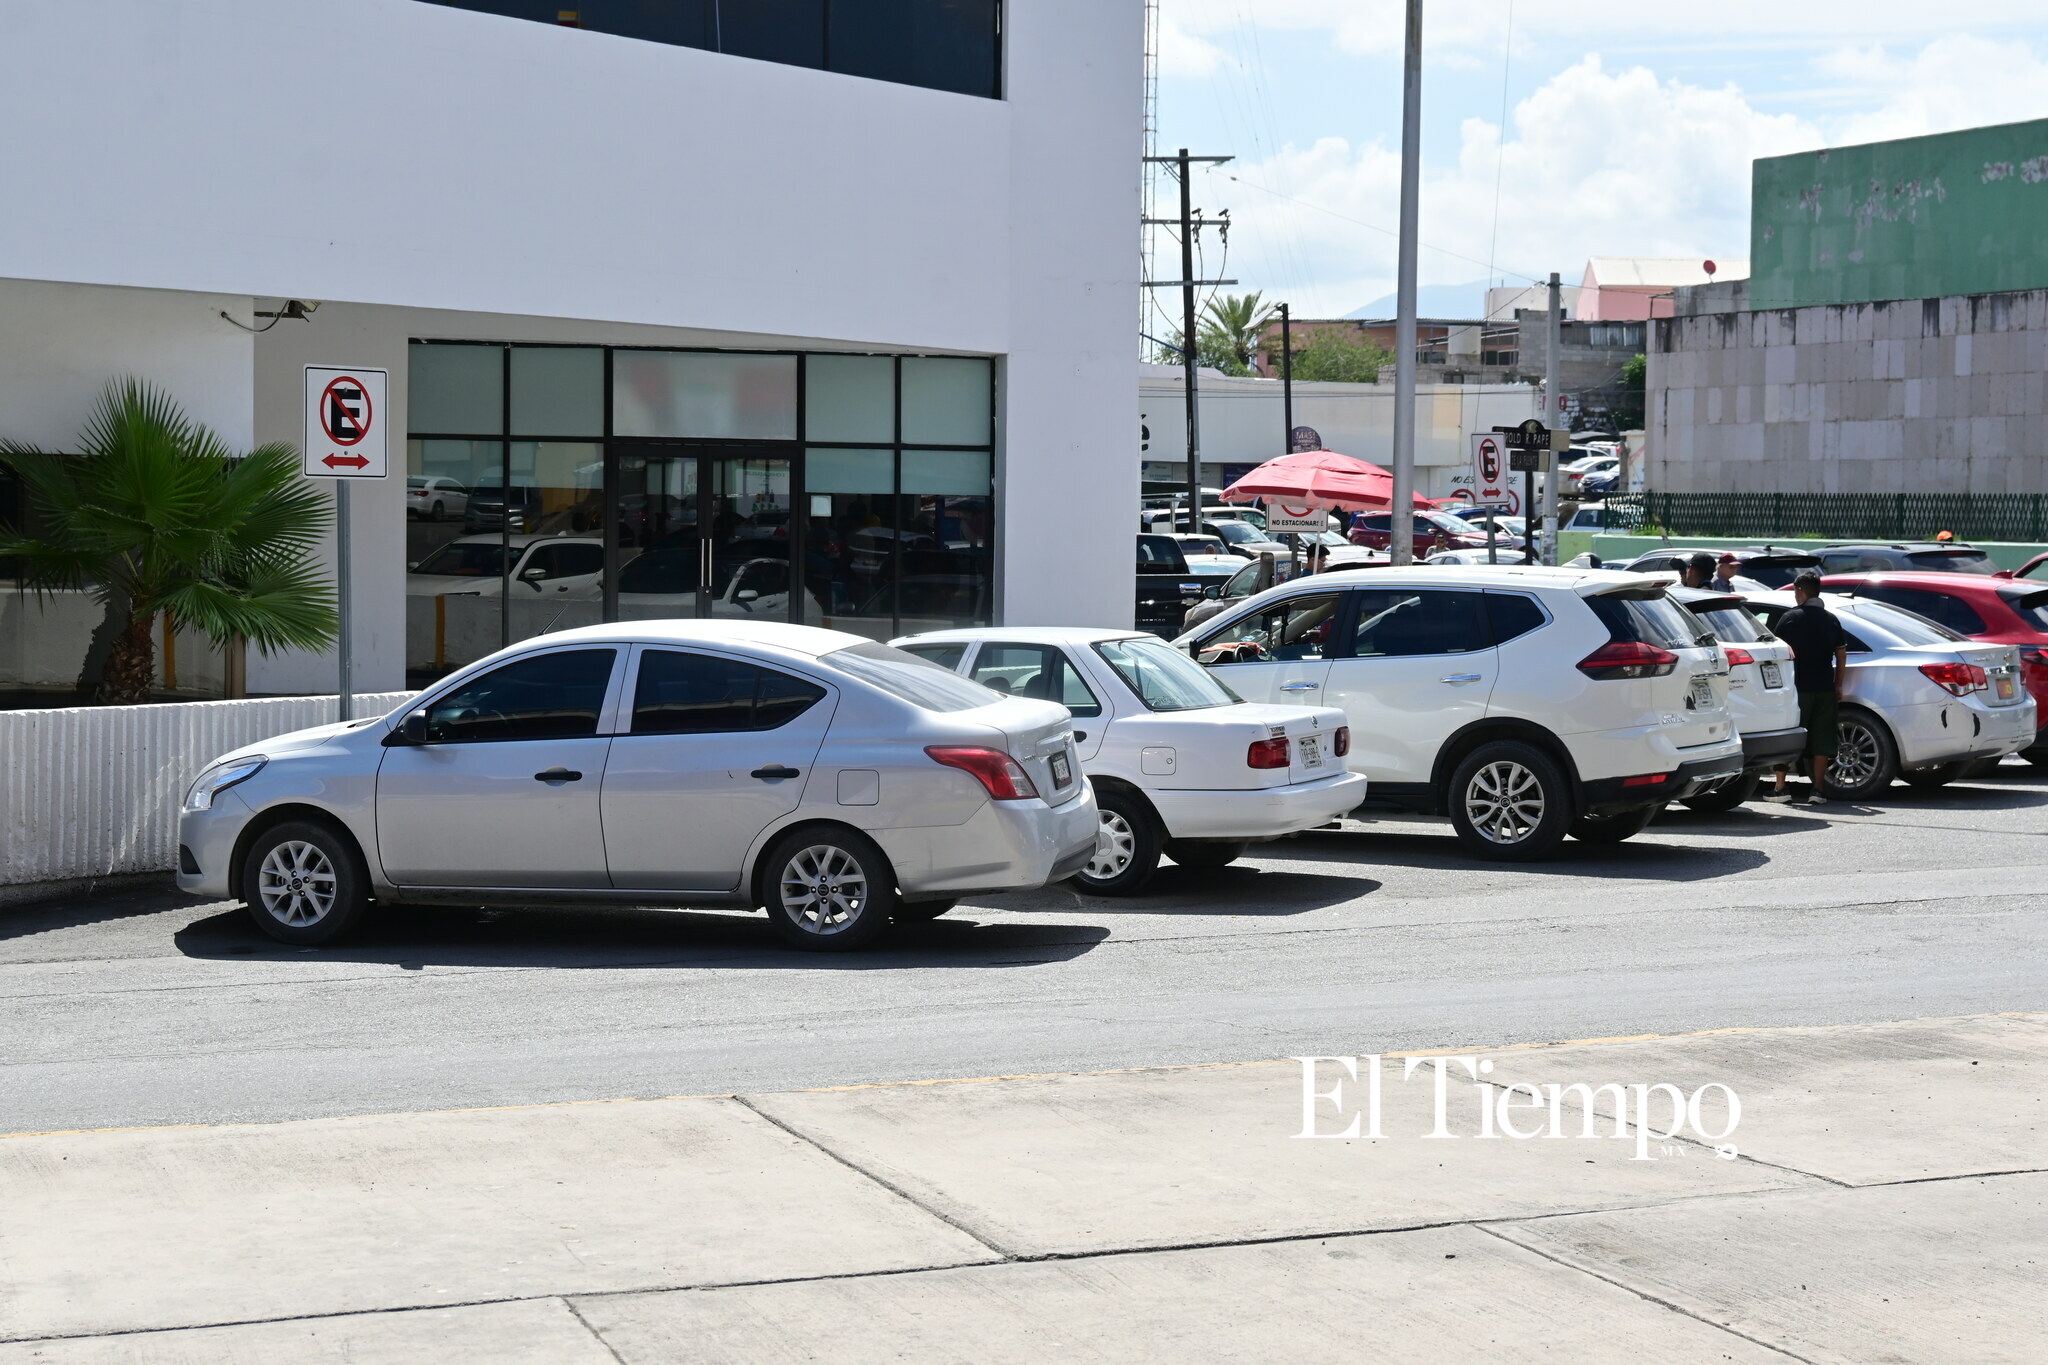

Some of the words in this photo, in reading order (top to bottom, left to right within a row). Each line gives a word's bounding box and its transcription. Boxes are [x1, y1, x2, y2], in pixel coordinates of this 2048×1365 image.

[331, 388, 361, 438] E
[1505, 432, 1521, 444] ROLD
[1533, 433, 1549, 445] PAPE
[1483, 446, 1496, 478] E
[1451, 475, 1462, 483] NO
